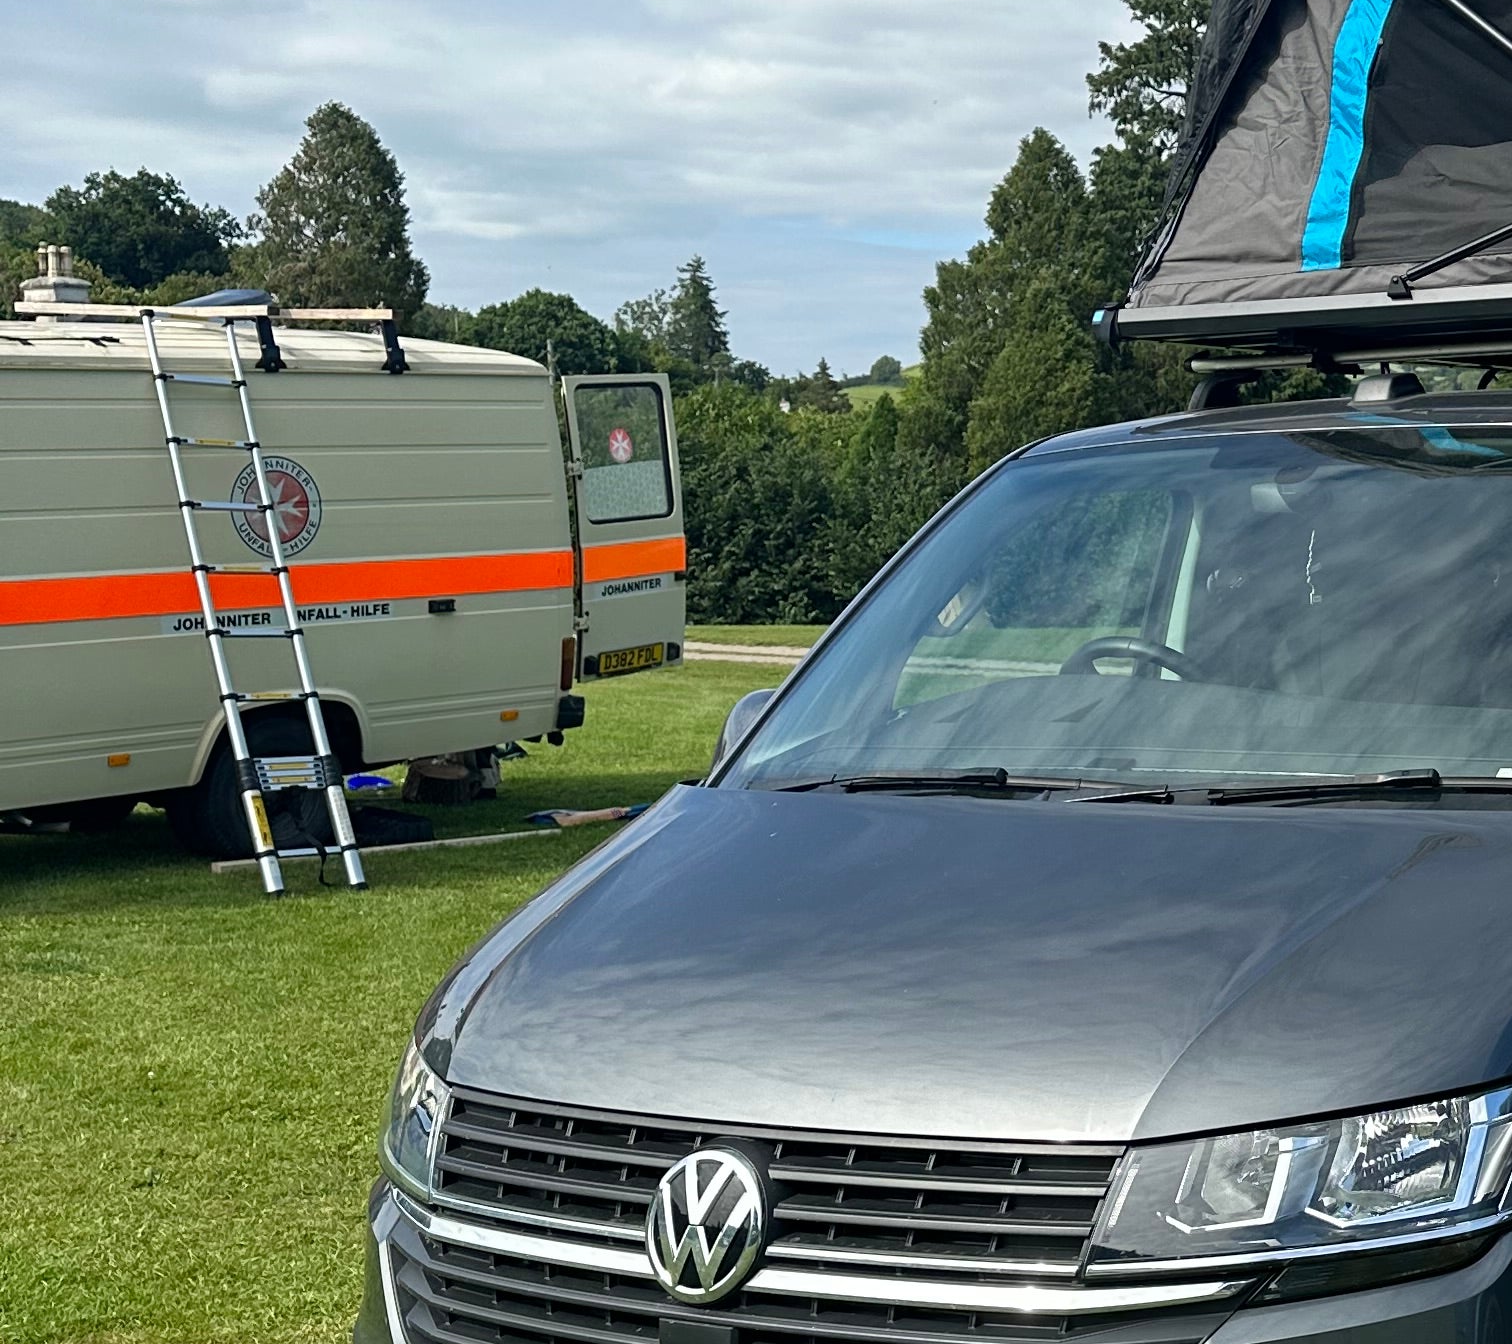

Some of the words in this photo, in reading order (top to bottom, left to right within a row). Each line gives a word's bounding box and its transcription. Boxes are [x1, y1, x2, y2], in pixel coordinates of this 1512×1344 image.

[236, 459, 314, 495] JOHNNITER-
[238, 518, 318, 553] UNFAL-HILFE
[601, 577, 662, 597] JOHANNITER
[173, 611, 272, 632] JOHNNITER
[603, 651, 636, 670] D382
[637, 646, 659, 664] FDL
